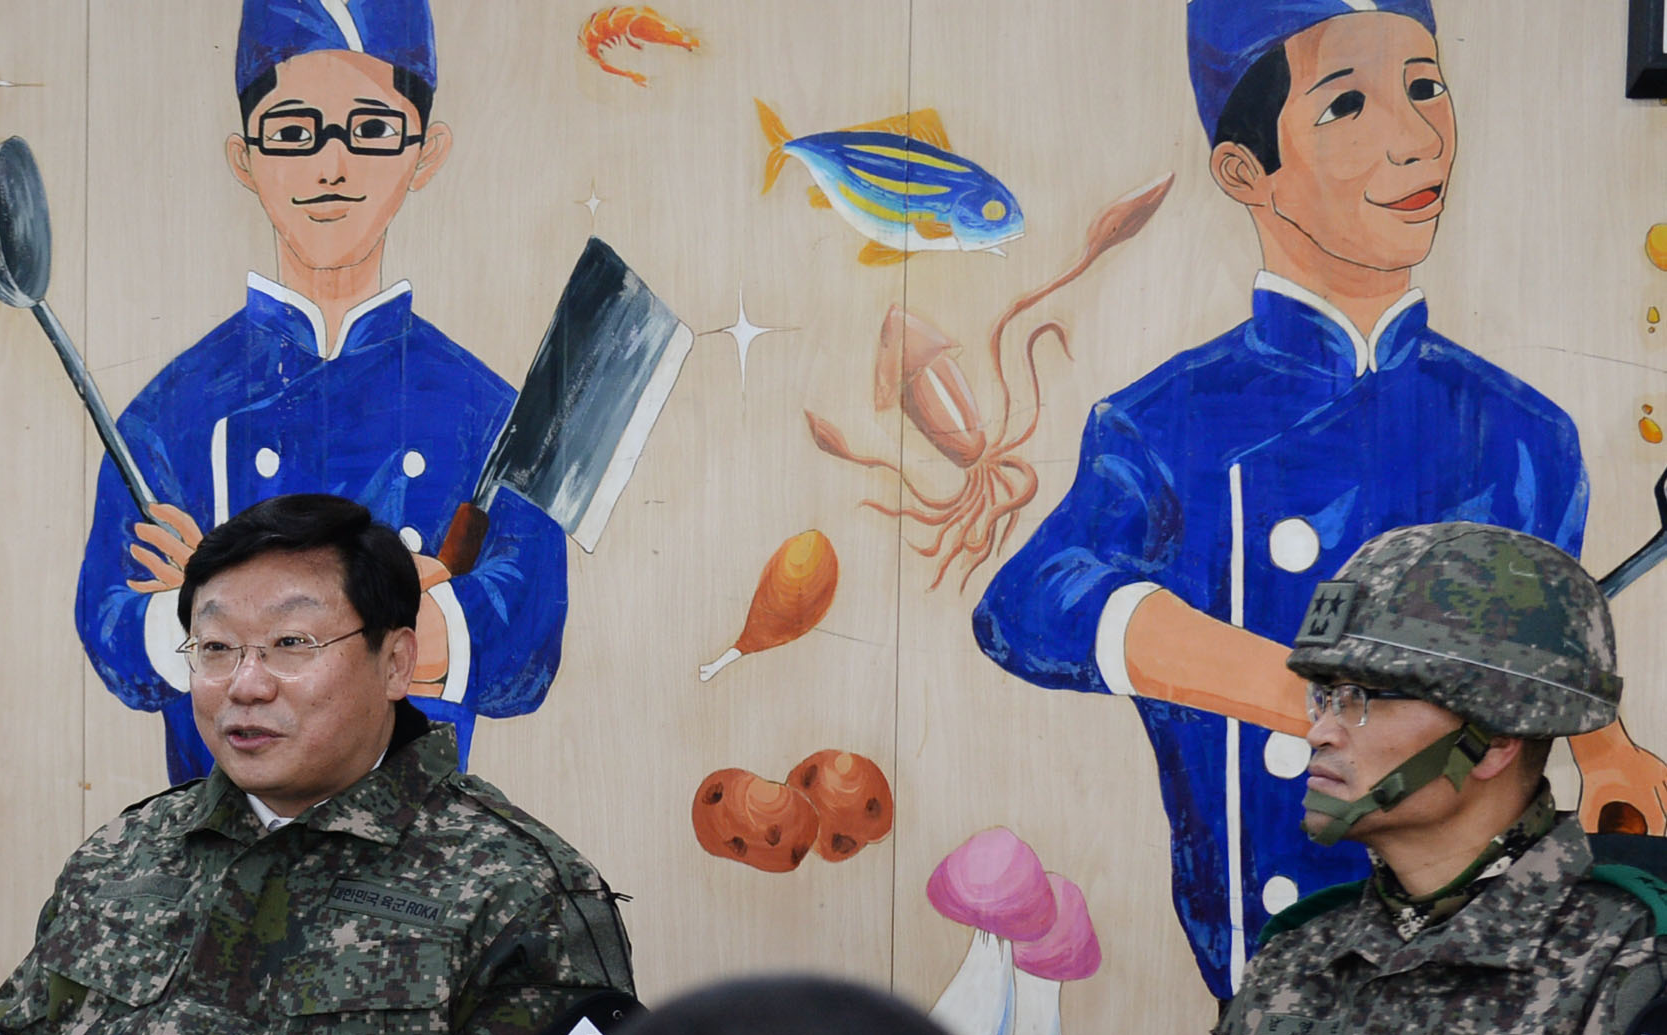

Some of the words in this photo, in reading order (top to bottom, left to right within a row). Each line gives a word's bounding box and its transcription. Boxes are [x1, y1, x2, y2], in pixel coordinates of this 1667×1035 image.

[333, 886, 380, 907] 대한민국
[380, 895, 407, 913] 육군
[405, 901, 440, 921] ROKA
